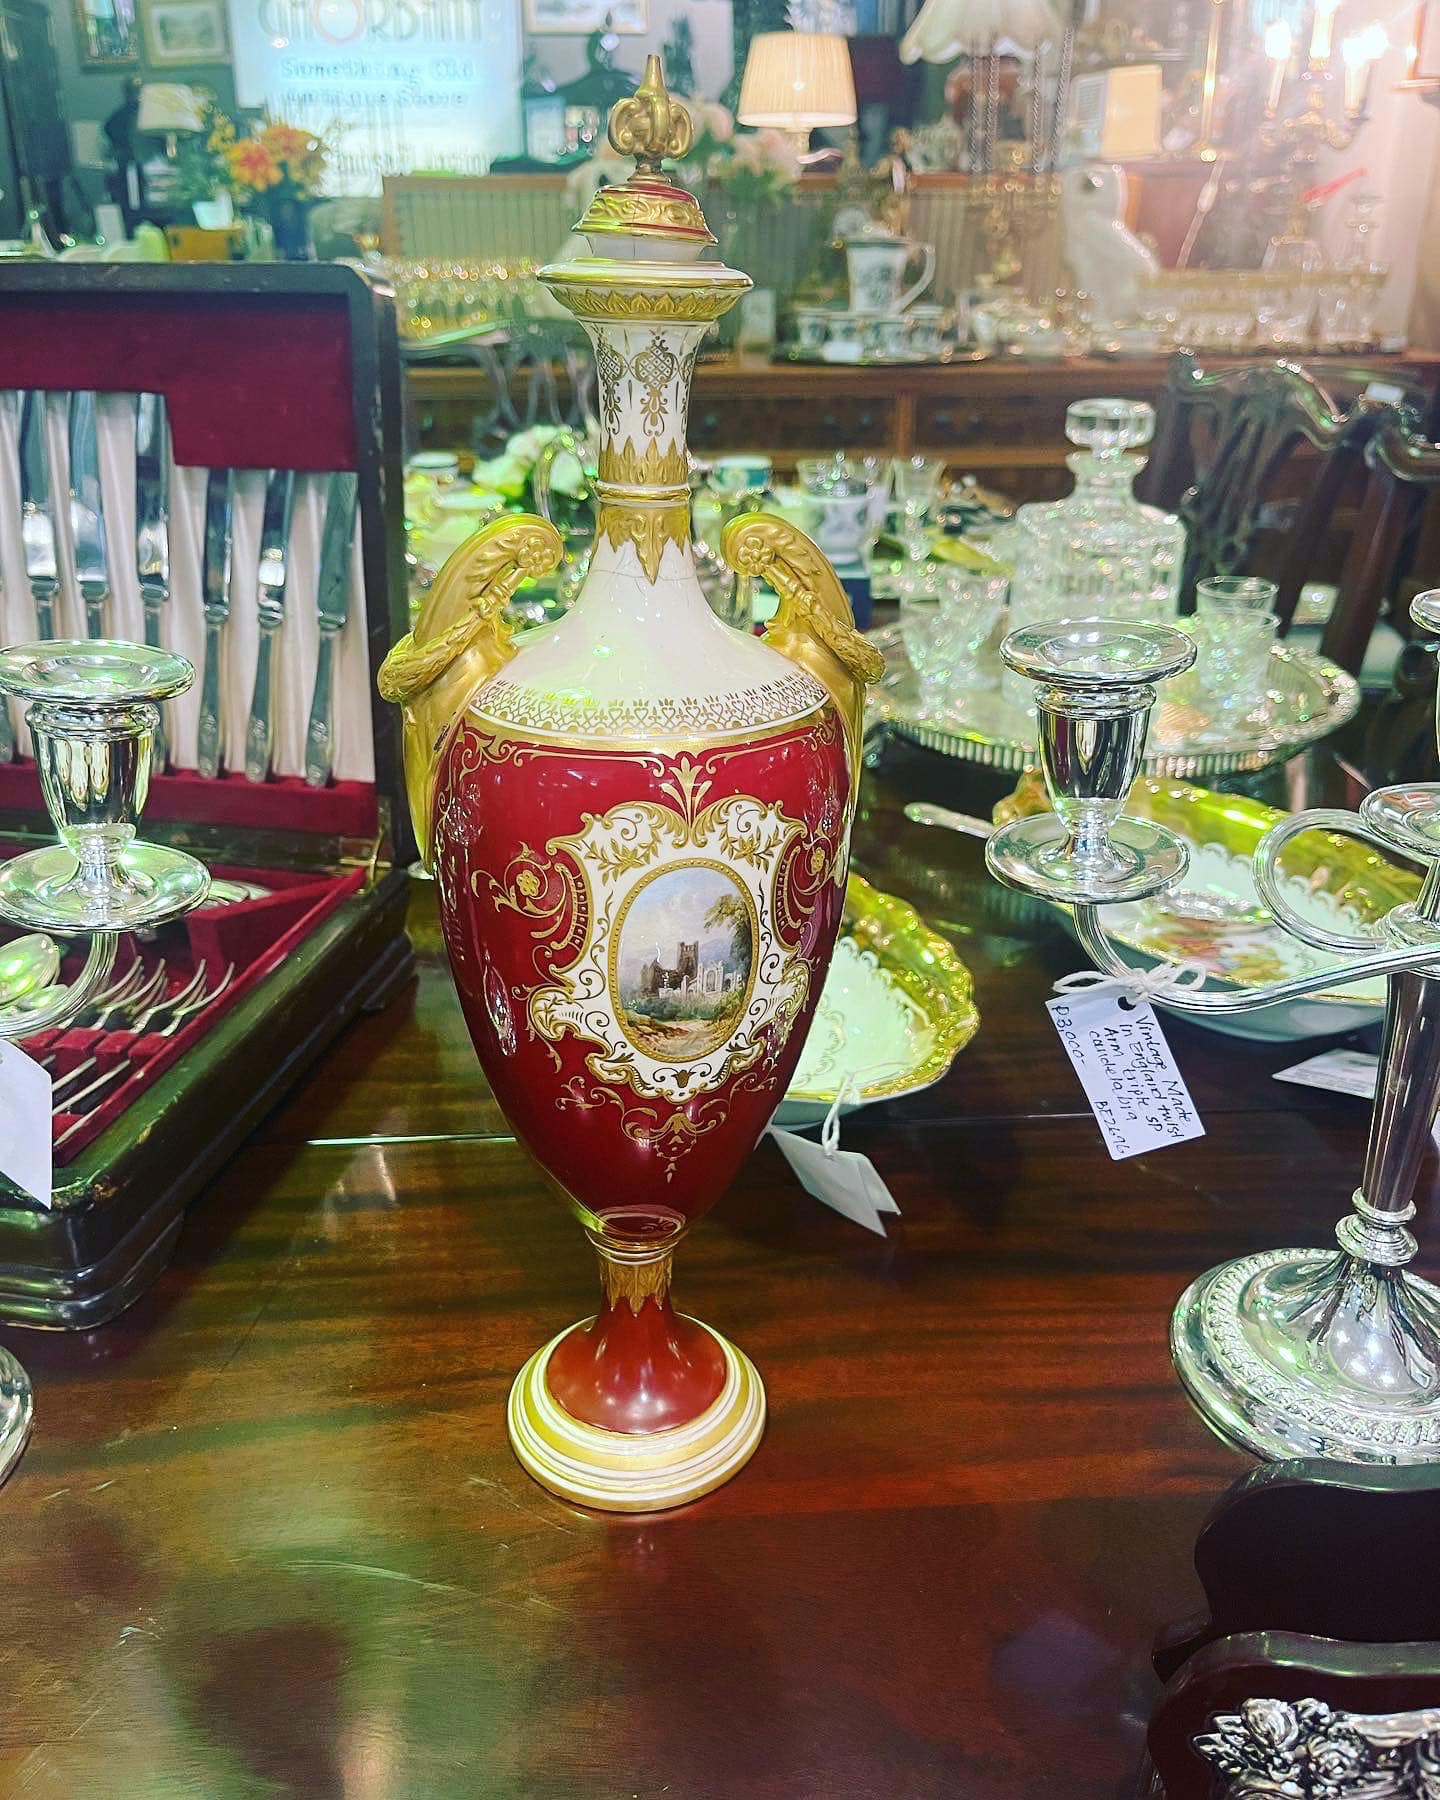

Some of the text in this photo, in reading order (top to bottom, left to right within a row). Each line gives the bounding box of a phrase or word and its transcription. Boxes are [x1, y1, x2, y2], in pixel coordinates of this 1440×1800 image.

[1122, 1068, 1150, 1107] triple
[1129, 1042, 1168, 1105] England
[1158, 1104, 1185, 1138] twist
[1135, 1015, 1193, 1123] Vintage Made
